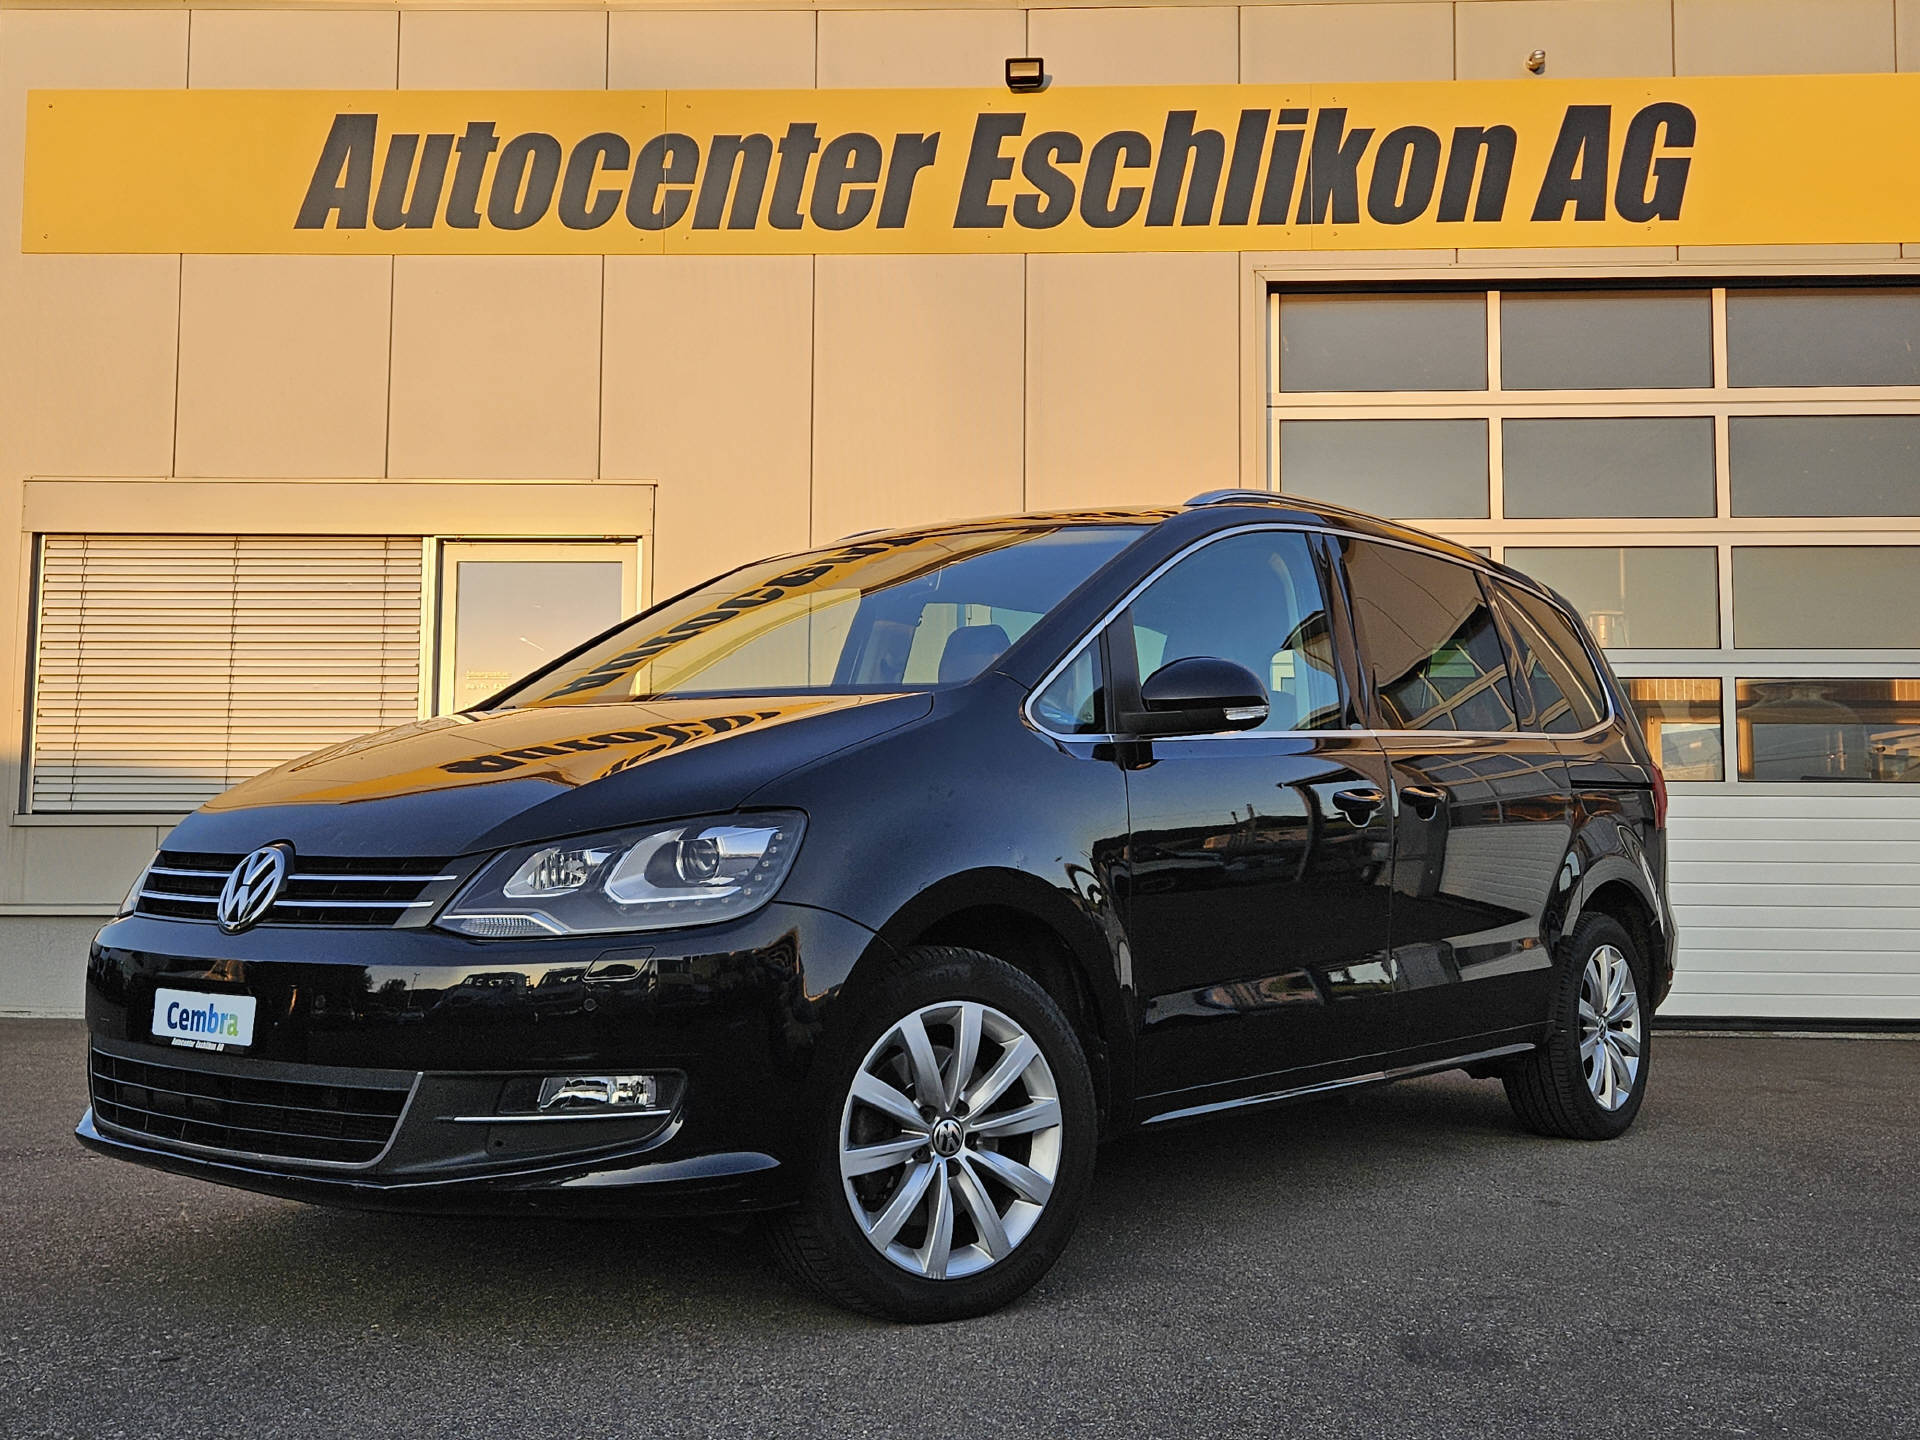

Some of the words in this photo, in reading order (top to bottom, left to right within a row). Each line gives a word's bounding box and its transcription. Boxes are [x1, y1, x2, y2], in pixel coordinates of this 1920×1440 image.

[293, 113, 941, 231] Autocenter
[952, 108, 1518, 230] Eschlikon
[1529, 101, 1697, 224] AG
[166, 1001, 239, 1037] Cembra
